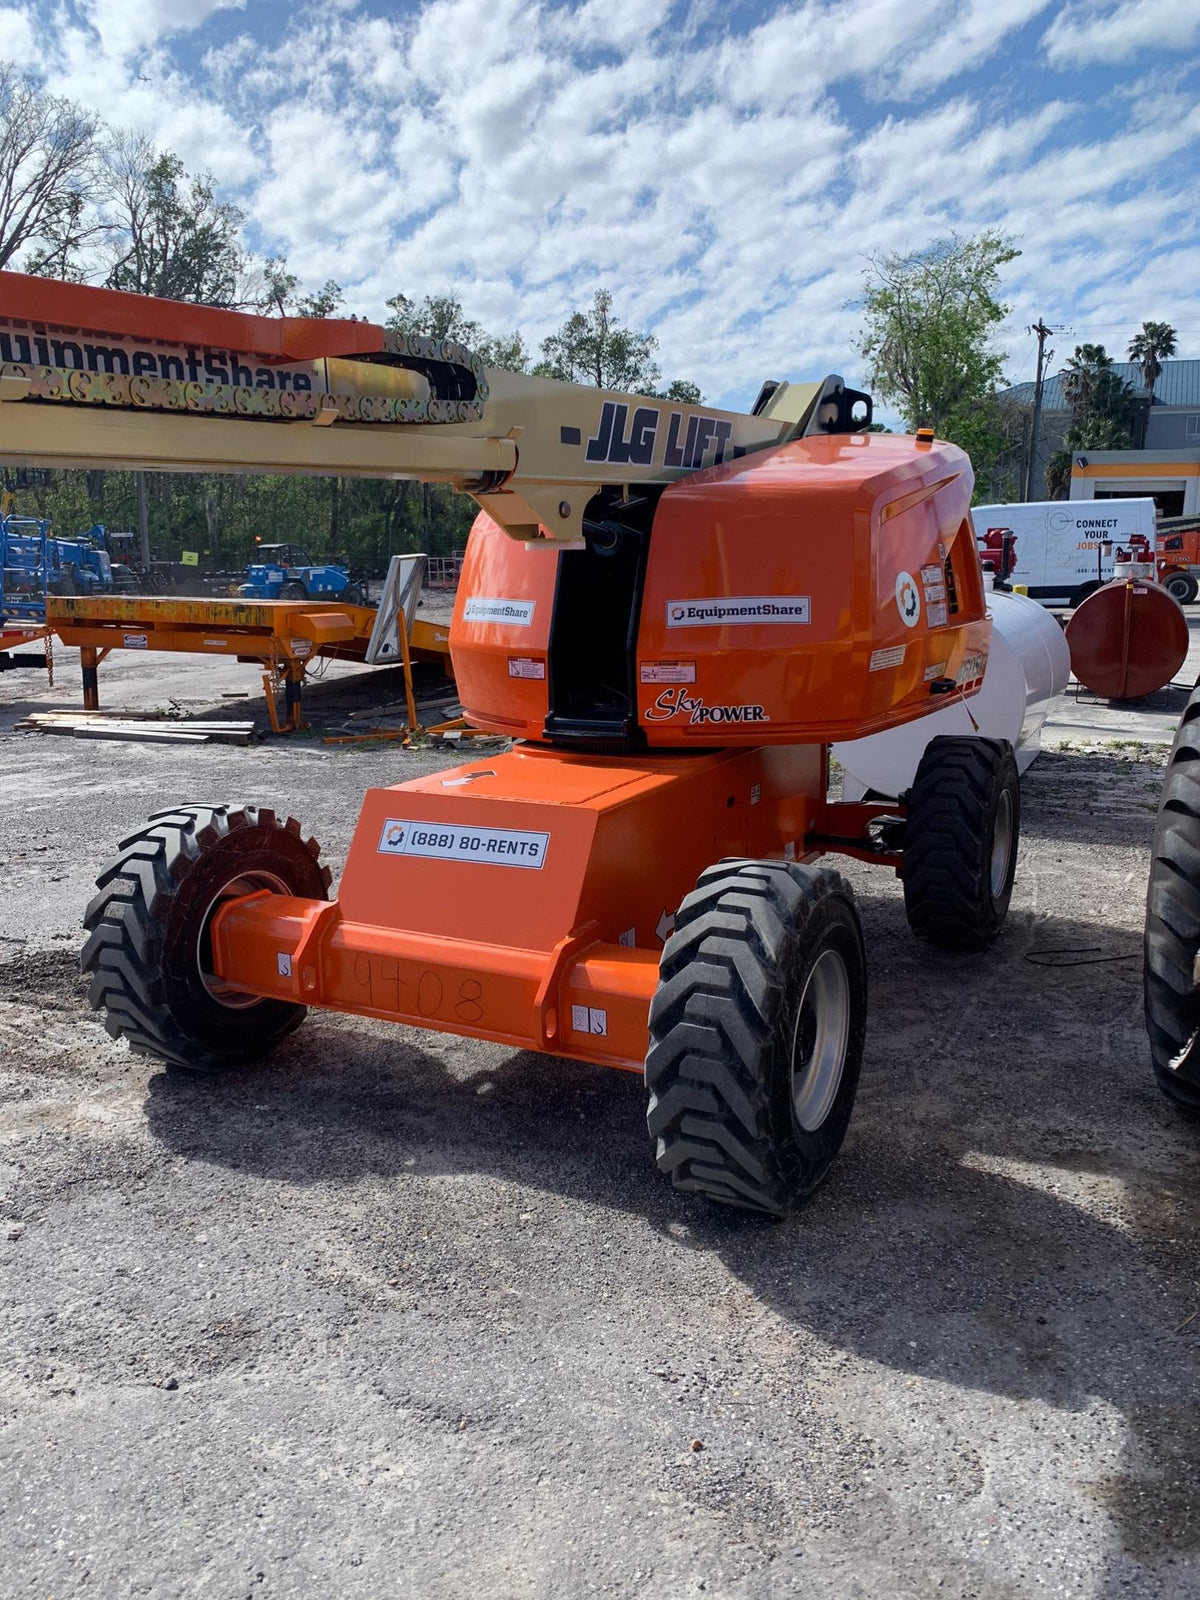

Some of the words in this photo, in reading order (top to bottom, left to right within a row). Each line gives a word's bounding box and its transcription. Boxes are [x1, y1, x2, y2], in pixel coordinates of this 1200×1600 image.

[585, 400, 660, 467] JLG
[663, 411, 732, 469] LIFT
[1076, 519, 1118, 528] CONNECT
[1084, 530, 1108, 539] YOUR
[687, 604, 803, 619] EquipmentShare
[411, 831, 455, 849] (888)
[459, 836, 540, 857] 80-RENTS
[354, 951, 483, 1021] 9408
